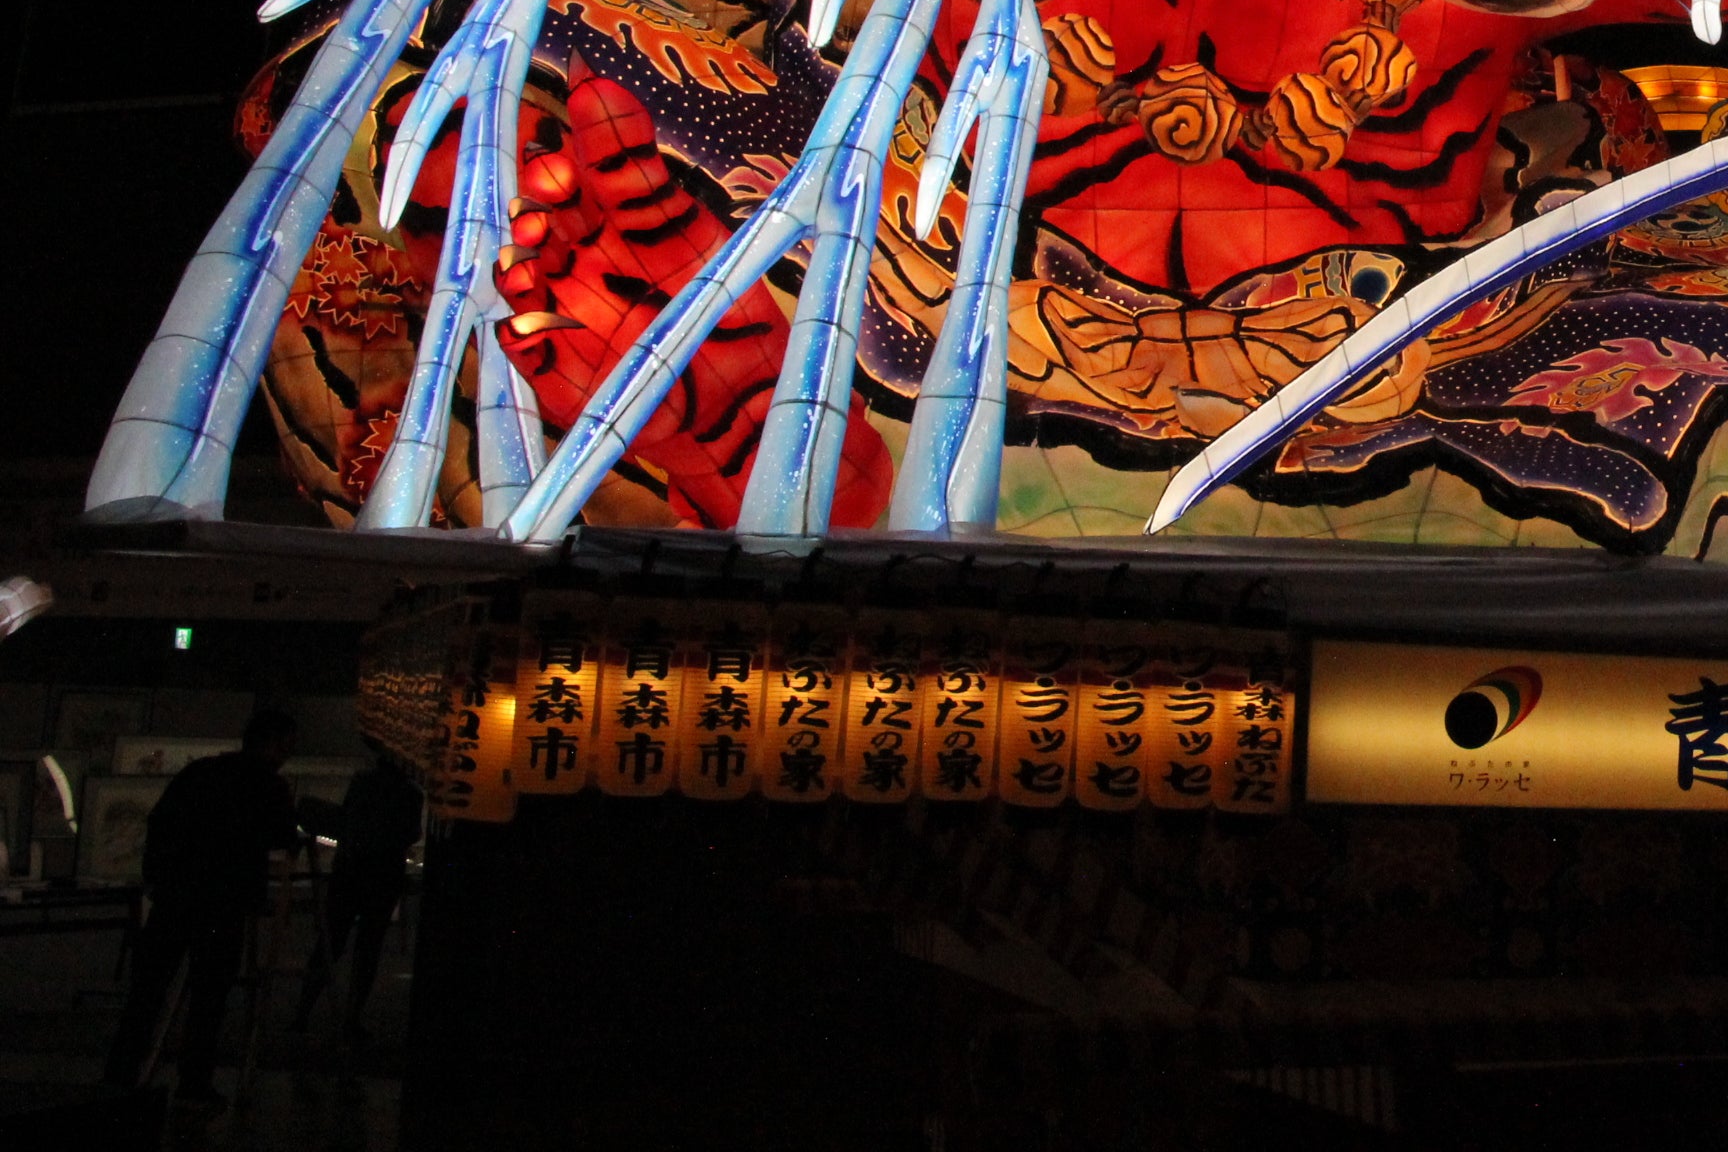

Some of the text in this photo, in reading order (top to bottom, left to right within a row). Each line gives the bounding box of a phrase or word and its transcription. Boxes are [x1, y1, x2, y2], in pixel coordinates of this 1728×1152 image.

[527, 611, 584, 780] 青森市
[614, 619, 670, 784] 青森市
[697, 623, 755, 787] 青森市
[1448, 773, 1531, 792] ワ・ラッセ
